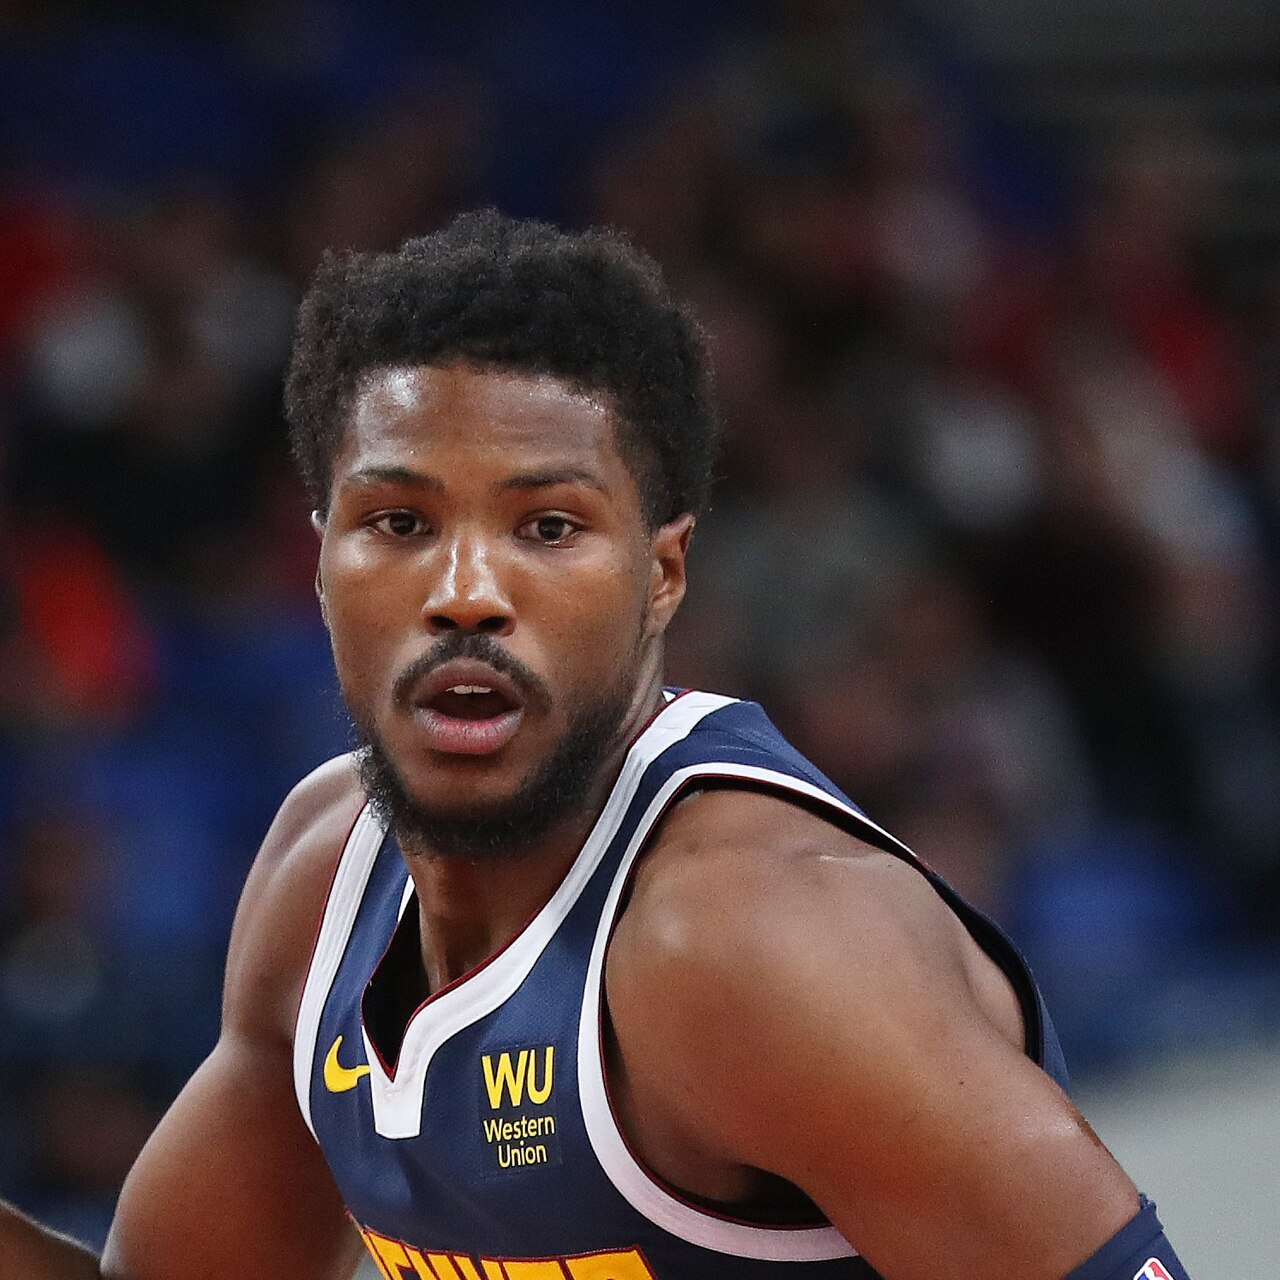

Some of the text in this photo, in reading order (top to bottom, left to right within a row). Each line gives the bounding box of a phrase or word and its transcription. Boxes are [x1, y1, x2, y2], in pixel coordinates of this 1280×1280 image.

[481, 1046, 554, 1109] WU
[483, 1113, 555, 1143] Western
[498, 1140, 547, 1168] Union
